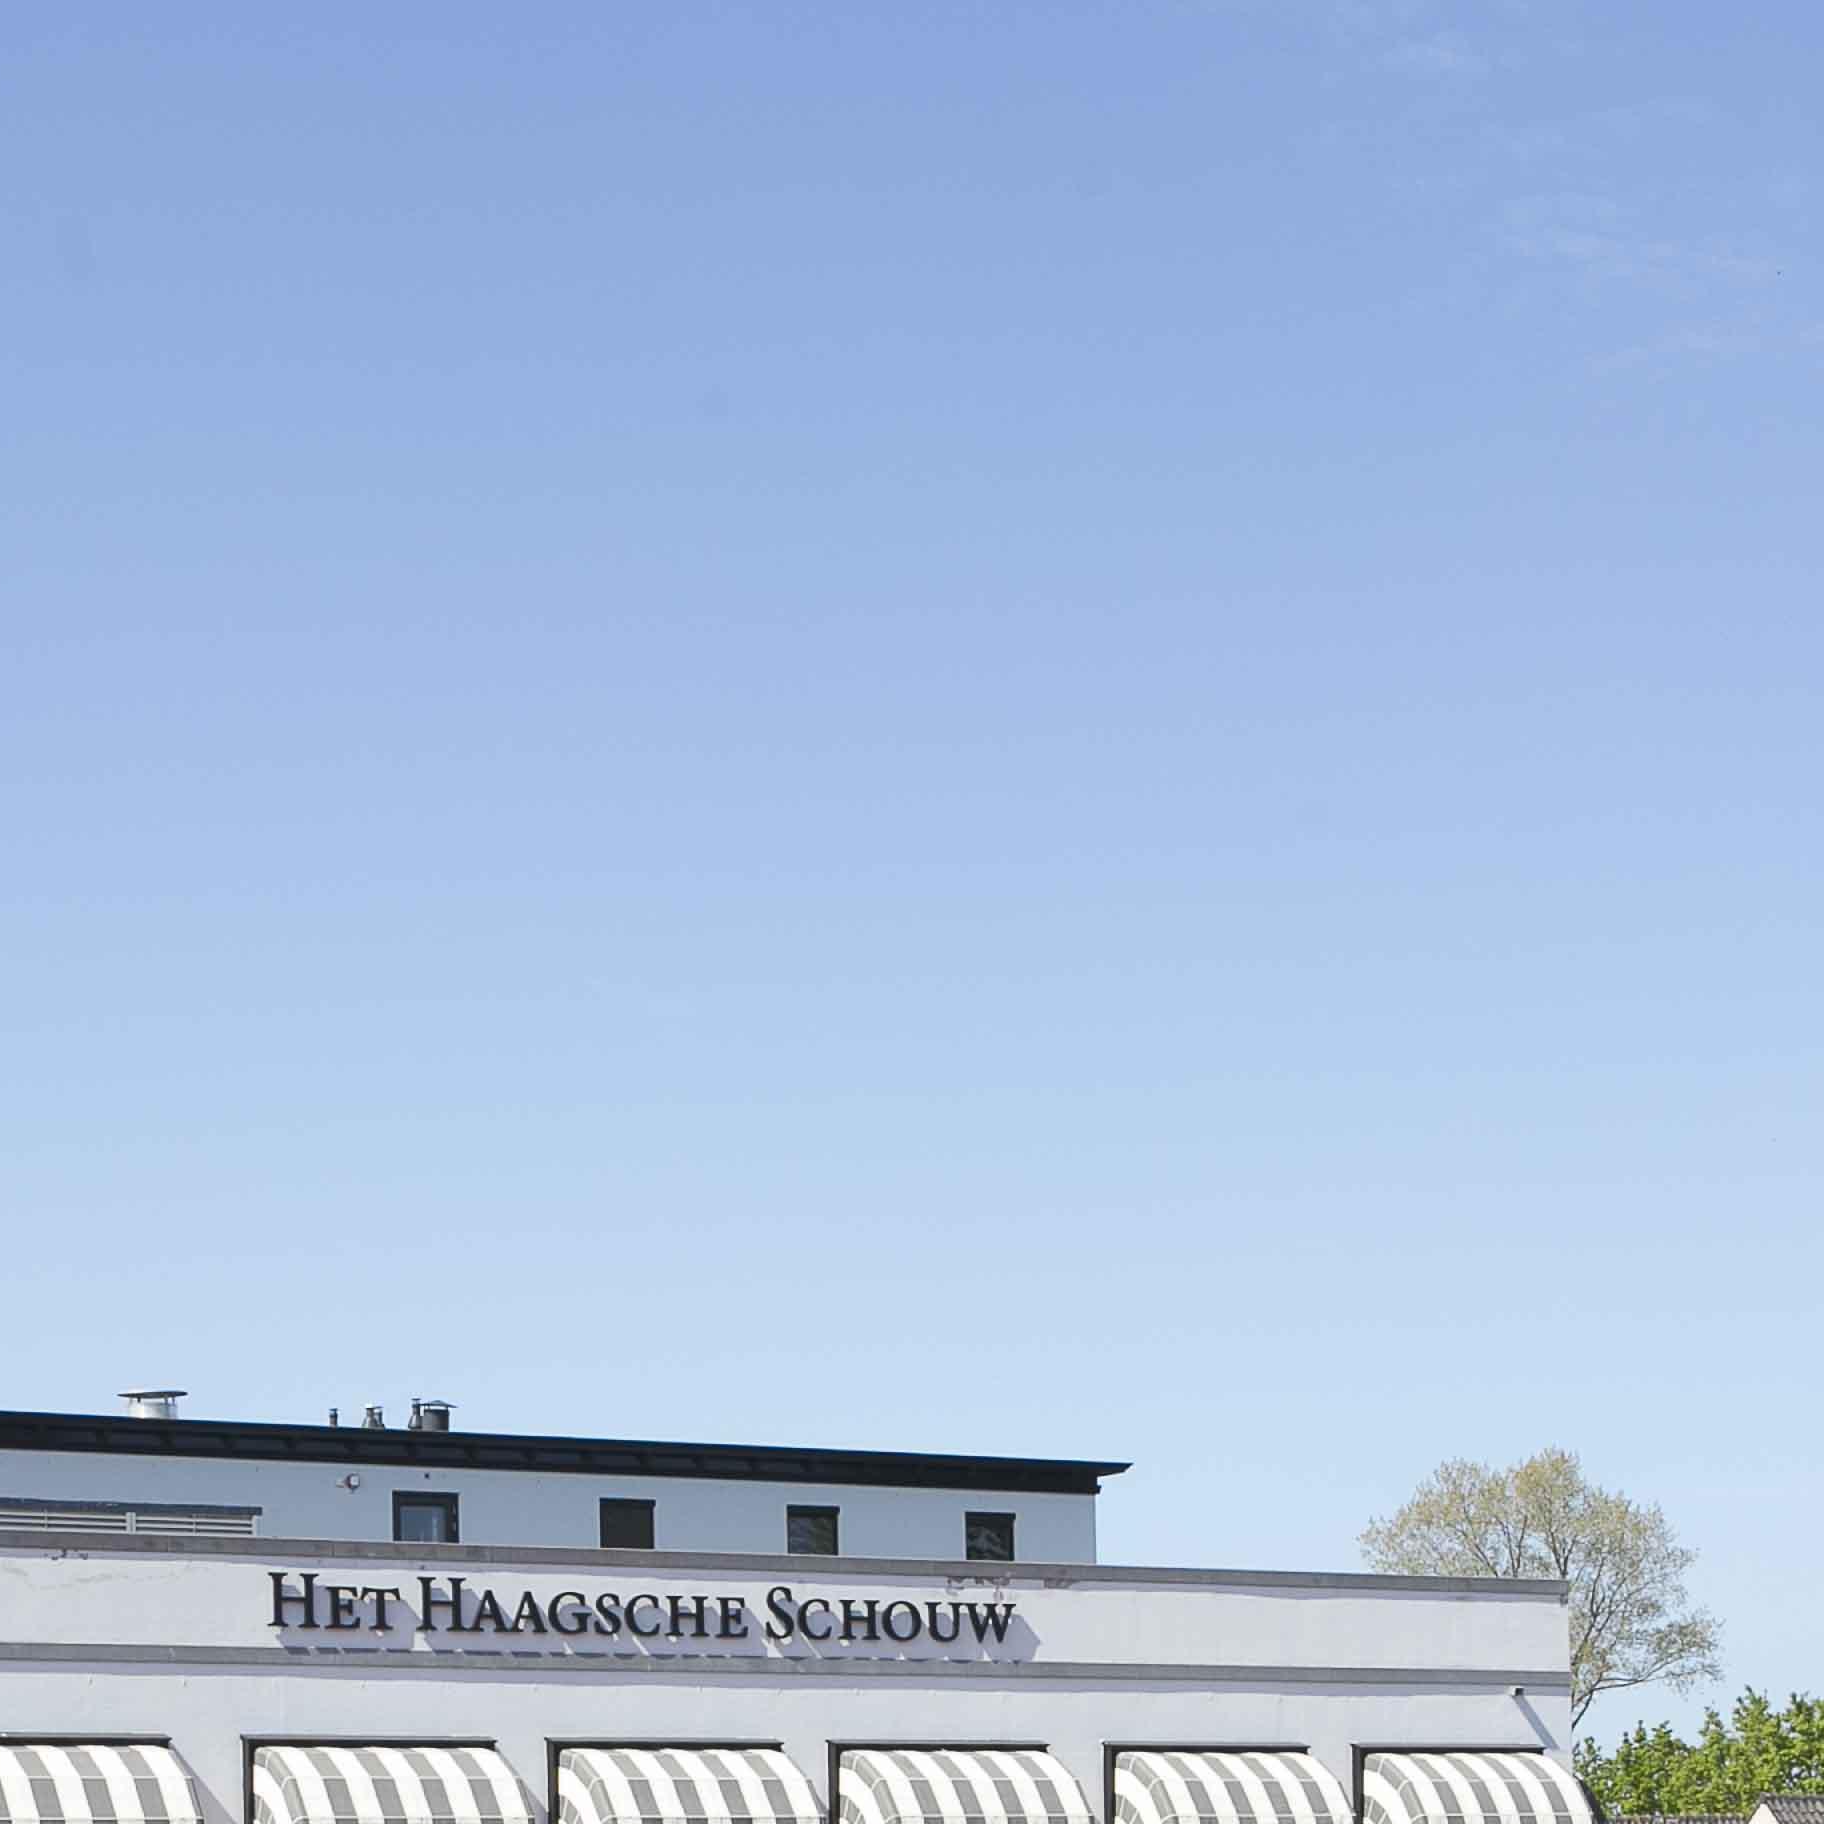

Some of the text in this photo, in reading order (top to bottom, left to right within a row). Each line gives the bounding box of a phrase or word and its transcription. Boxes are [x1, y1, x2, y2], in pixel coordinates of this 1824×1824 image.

[266, 1571, 1018, 1644] HET HAAGSCHE SCHOUW
